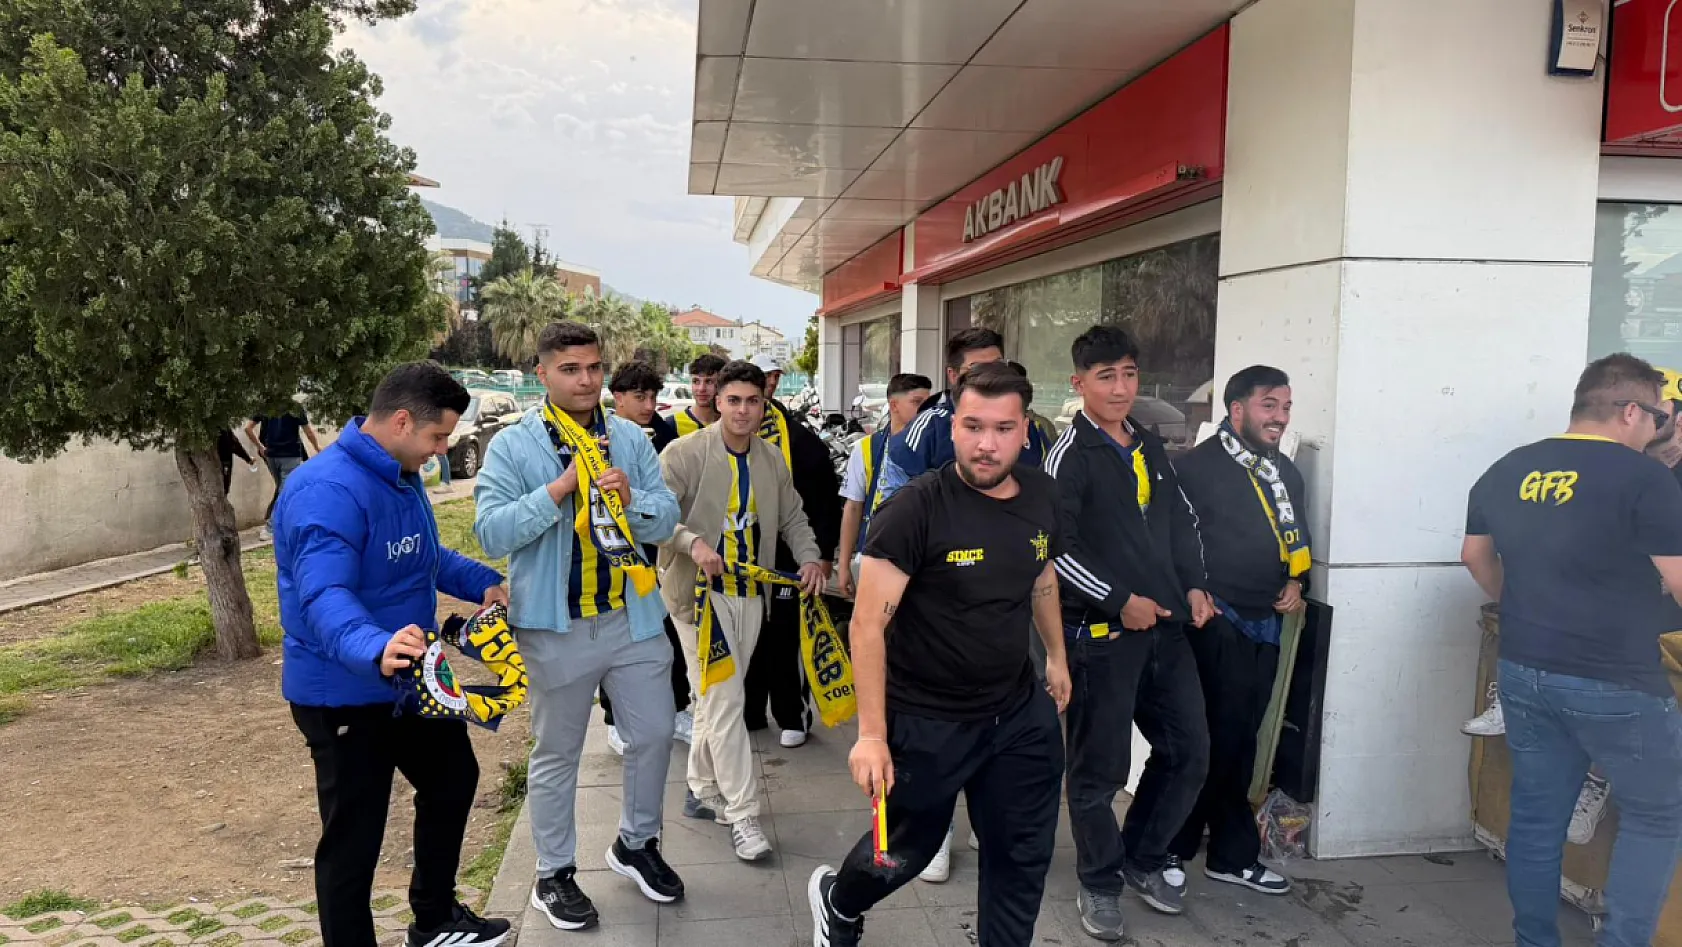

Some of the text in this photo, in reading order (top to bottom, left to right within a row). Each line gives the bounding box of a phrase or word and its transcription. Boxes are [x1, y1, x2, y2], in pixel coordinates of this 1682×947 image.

[1568, 24, 1596, 34] Senkron
[962, 155, 1064, 243] AKBANK
[1519, 471, 1578, 506] GFB
[386, 533, 421, 562] 1907
[946, 548, 984, 562] SINCE
